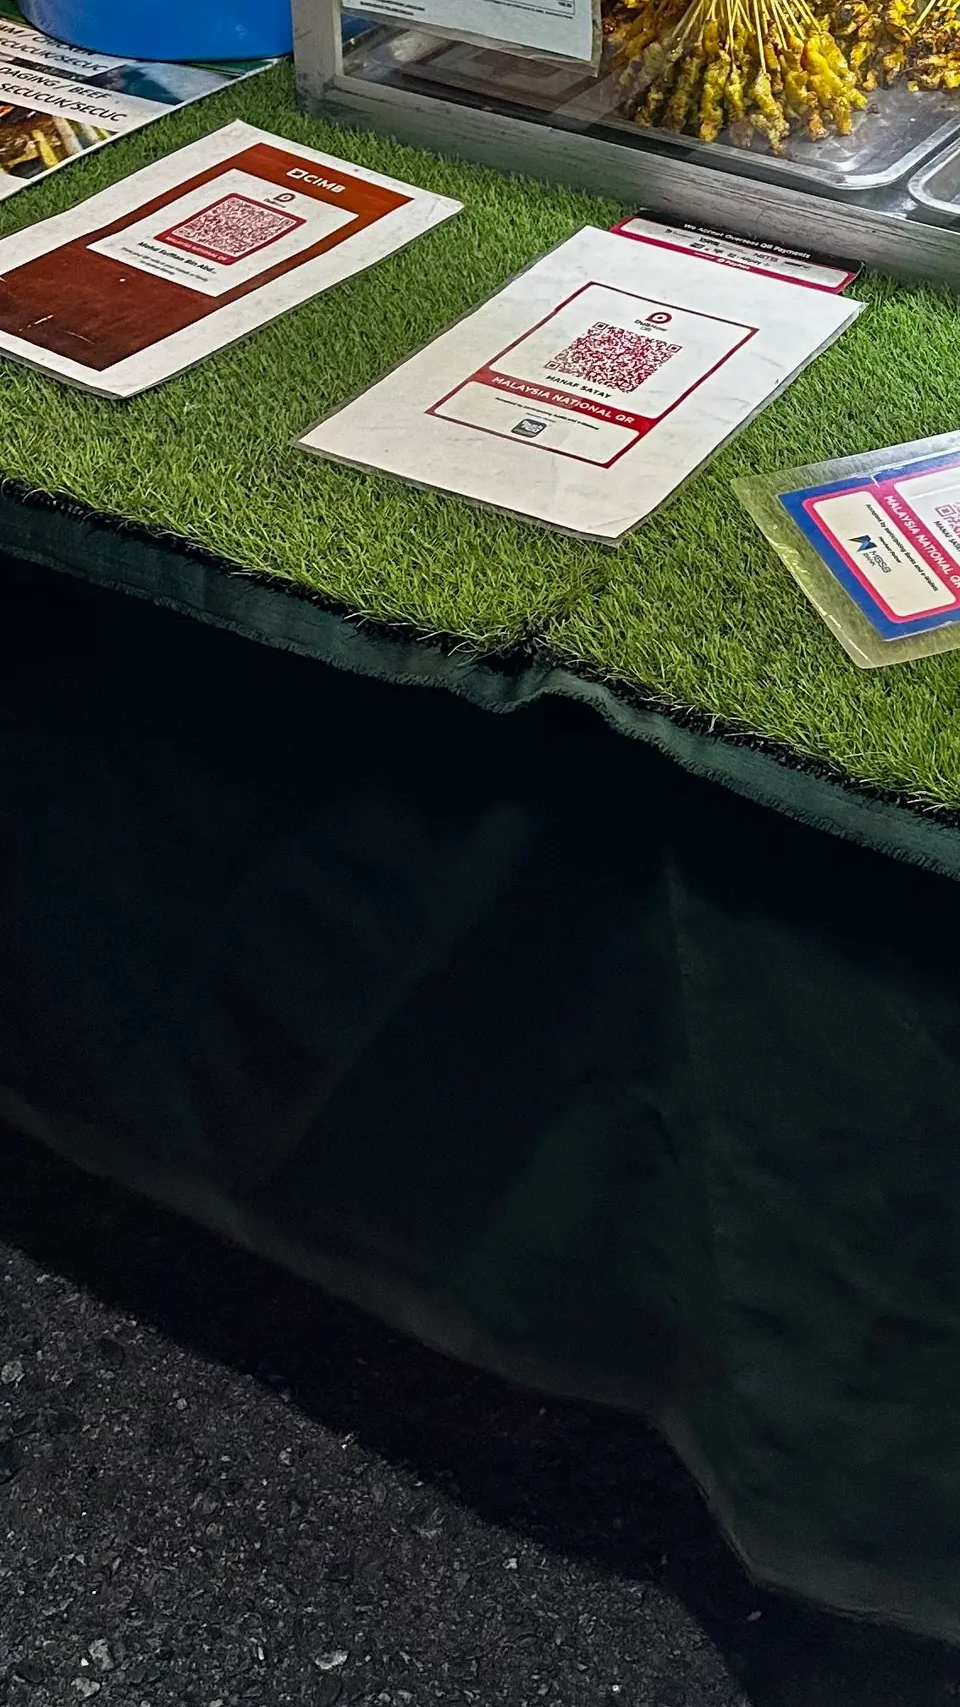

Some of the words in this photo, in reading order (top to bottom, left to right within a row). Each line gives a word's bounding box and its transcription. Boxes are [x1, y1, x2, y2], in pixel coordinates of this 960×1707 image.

[0, 67, 60, 86] DAGING
[68, 86, 112, 100] BEEF
[302, 171, 345, 193] CIMB
[491, 376, 551, 400] MALAYSIA
[552, 394, 612, 419] NATIONAL
[615, 414, 635, 425] QR
[545, 375, 579, 389] MANAF
[580, 385, 612, 399] SATAY
[884, 495, 920, 534] MALAYSIA
[916, 534, 953, 575] NATIONAL
